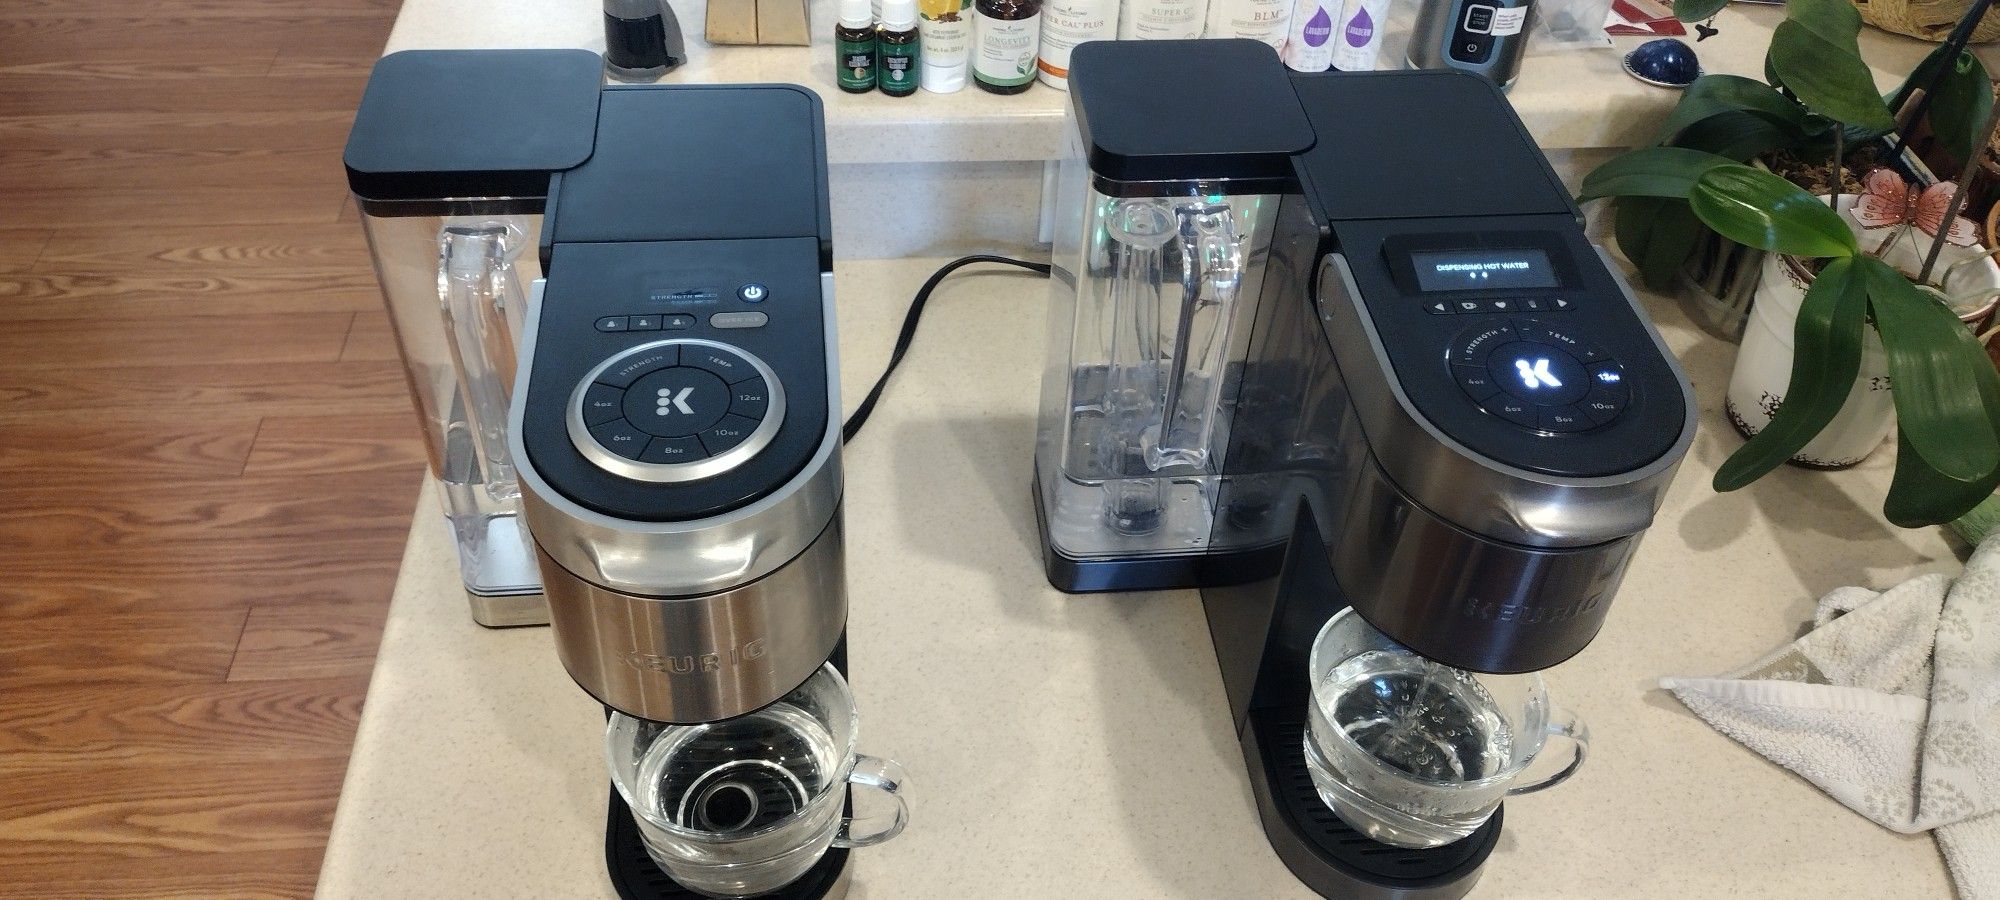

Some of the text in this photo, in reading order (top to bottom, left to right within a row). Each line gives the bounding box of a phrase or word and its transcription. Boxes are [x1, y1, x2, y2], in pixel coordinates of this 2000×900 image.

[1254, 10, 1279, 21] BLM
[1083, 20, 1104, 29] PLUS
[1436, 263, 1483, 272] DISPENSING
[1501, 262, 1529, 270] WATER
[1465, 329, 1498, 355] STRENGTH
[1548, 330, 1576, 345] TEMP
[619, 355, 663, 376] STRENGTH
[708, 355, 733, 368] TEMP
[617, 638, 769, 675] KEURIG
